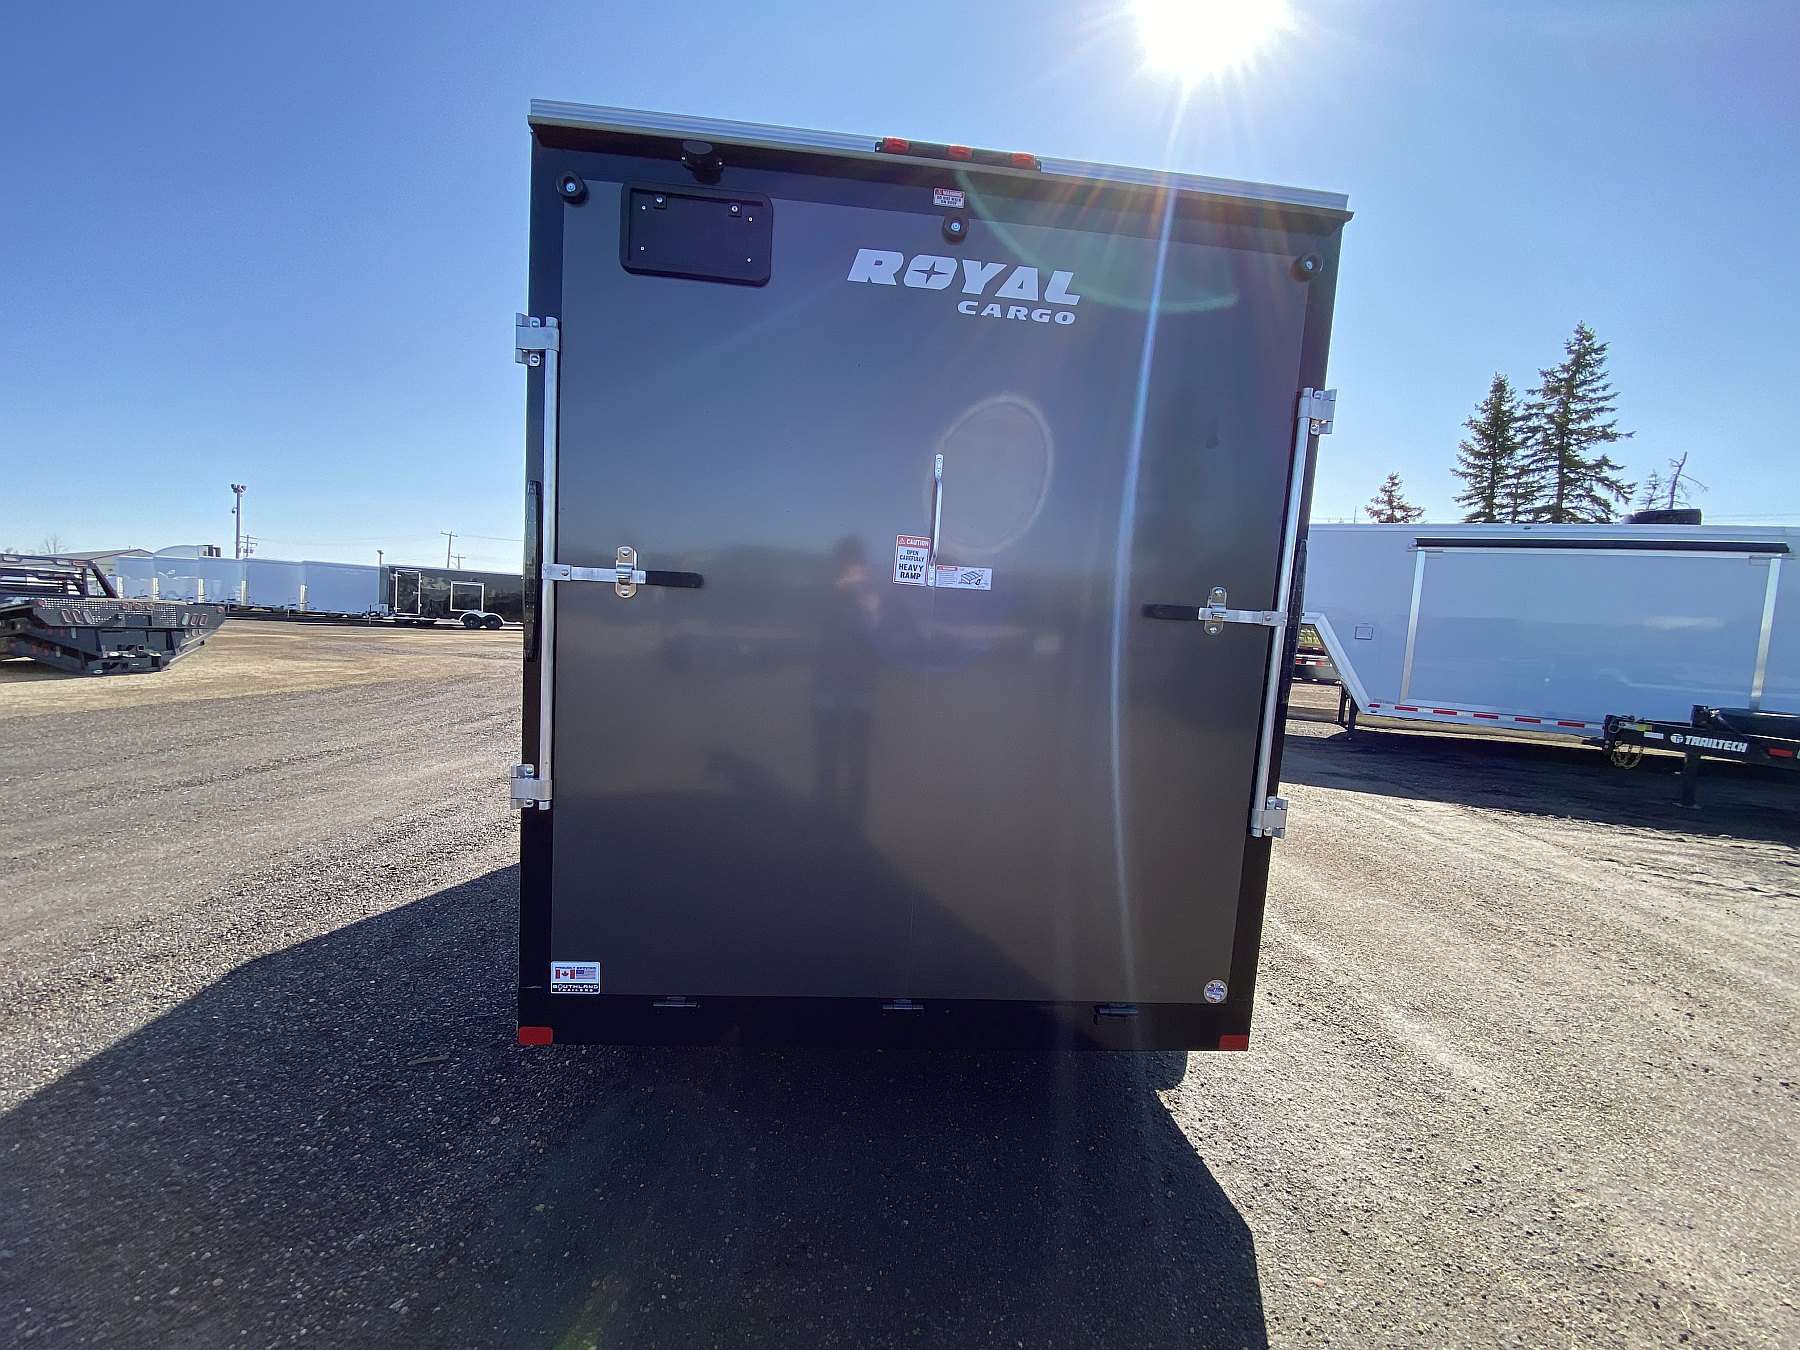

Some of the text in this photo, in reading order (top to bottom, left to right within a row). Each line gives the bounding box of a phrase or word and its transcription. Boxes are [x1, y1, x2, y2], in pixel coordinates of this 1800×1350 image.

[847, 248, 1081, 305] ROYAL
[957, 301, 1076, 325] CARGO
[906, 539, 929, 547] CAUTION
[898, 563, 924, 573] HEAVY
[900, 571, 921, 580] RAMP
[1685, 735, 1748, 752] TRAILTECH
